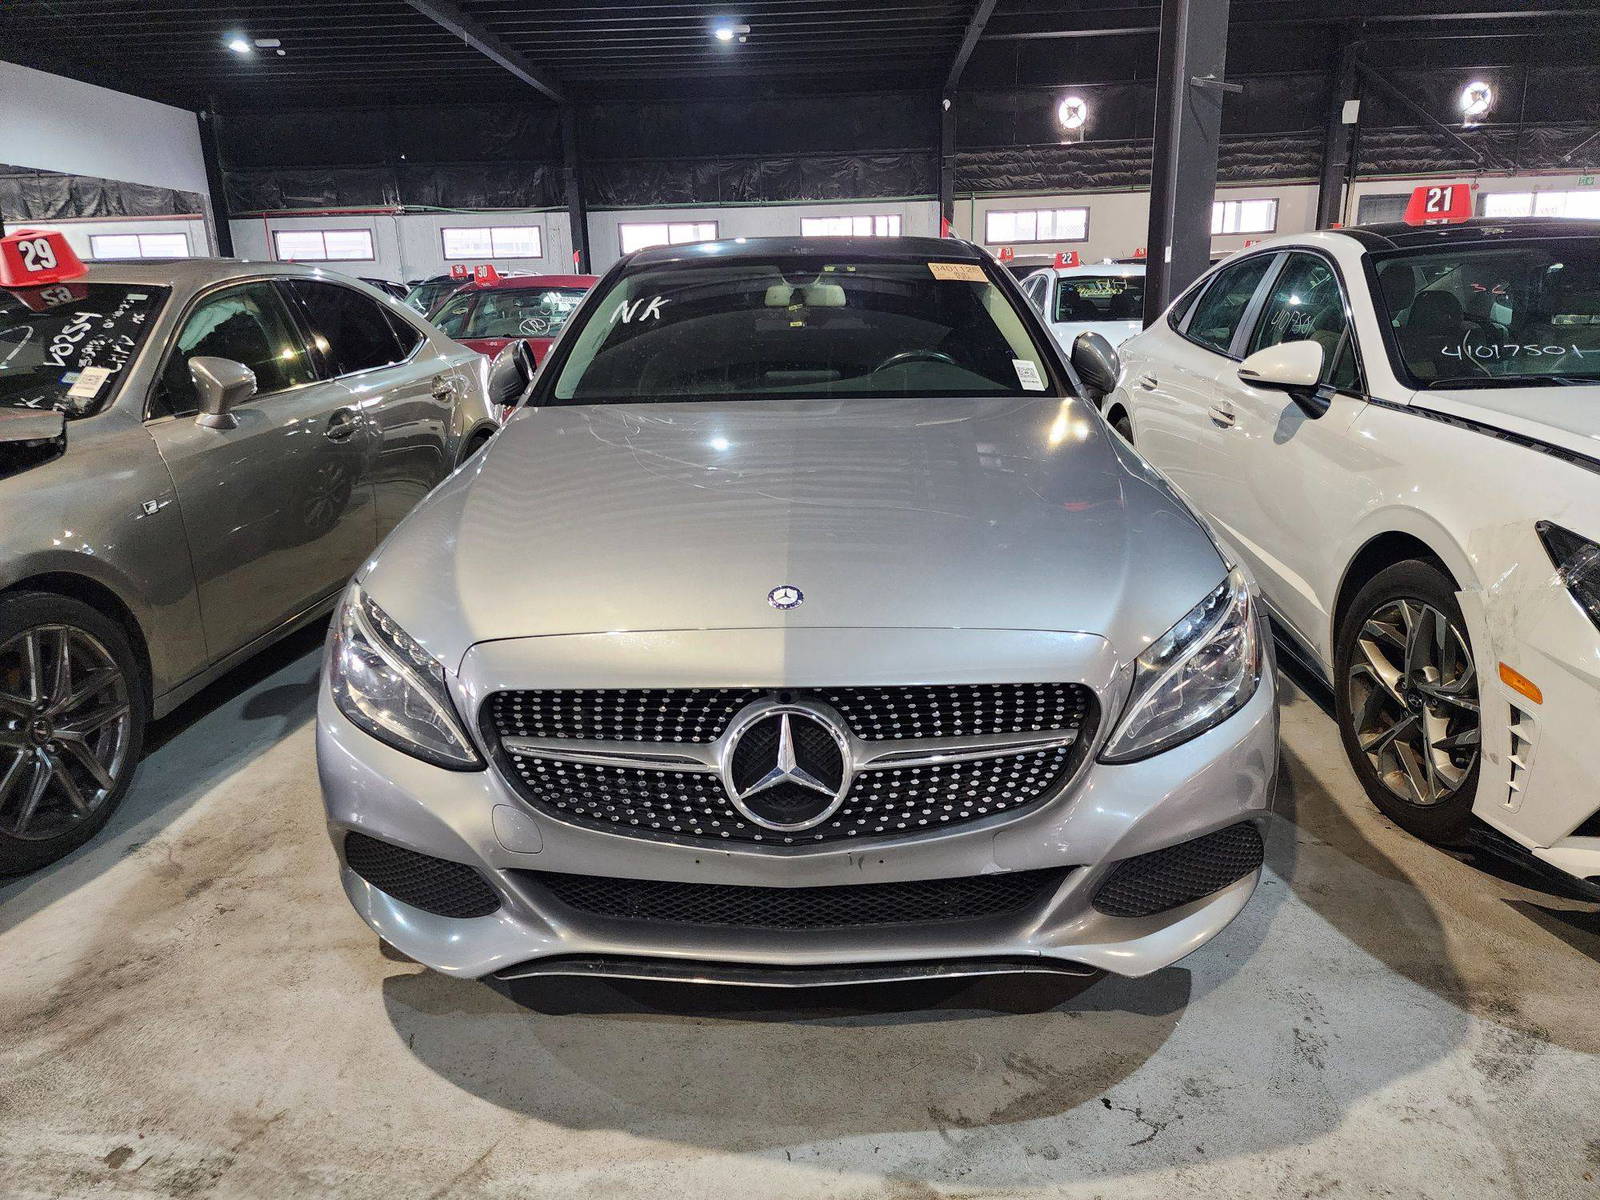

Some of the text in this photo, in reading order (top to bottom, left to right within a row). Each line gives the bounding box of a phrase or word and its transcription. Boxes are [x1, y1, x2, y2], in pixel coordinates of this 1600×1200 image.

[1427, 186, 1452, 213] 21
[18, 238, 57, 272] 29
[1061, 252, 1072, 264] 22
[477, 265, 488, 278] 30
[1441, 344, 1584, 361] 41017501
